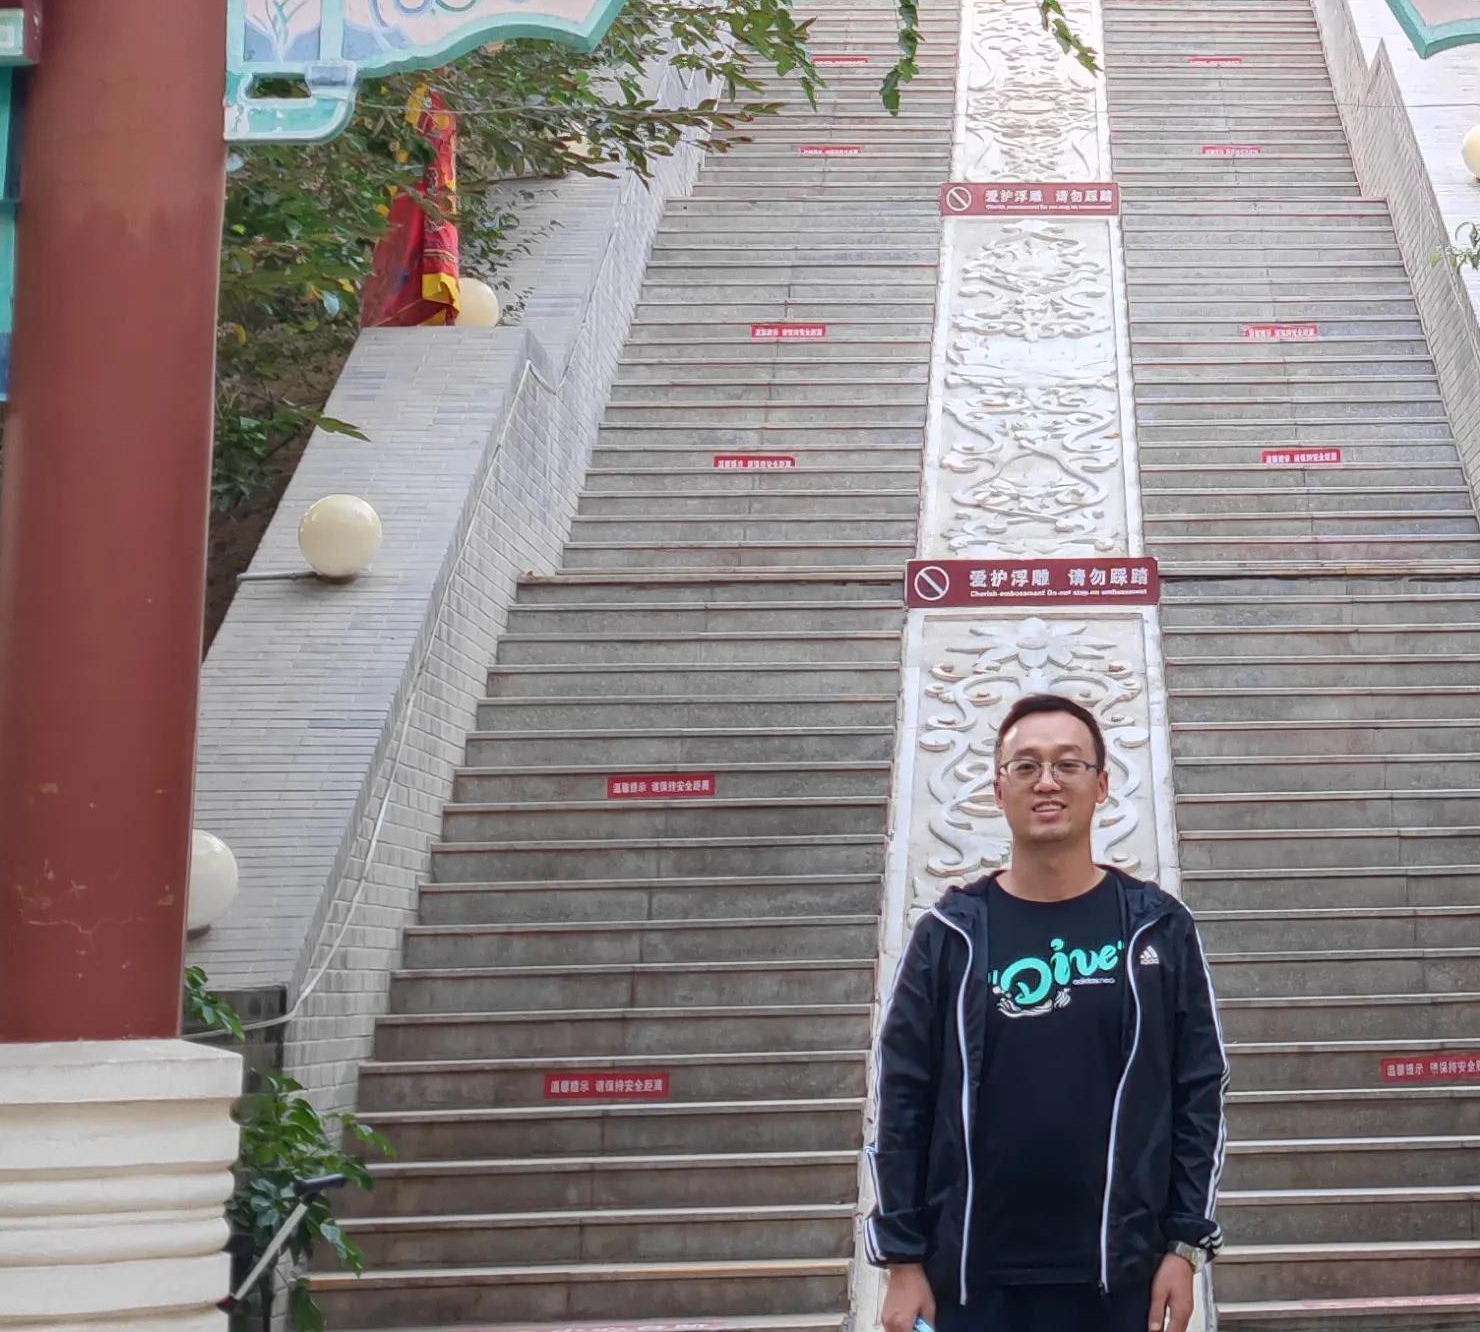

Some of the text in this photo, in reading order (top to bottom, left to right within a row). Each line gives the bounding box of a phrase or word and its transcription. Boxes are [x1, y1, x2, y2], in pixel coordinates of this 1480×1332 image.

[969, 567, 1149, 587] 爱护浮雕 请勿踩踏
